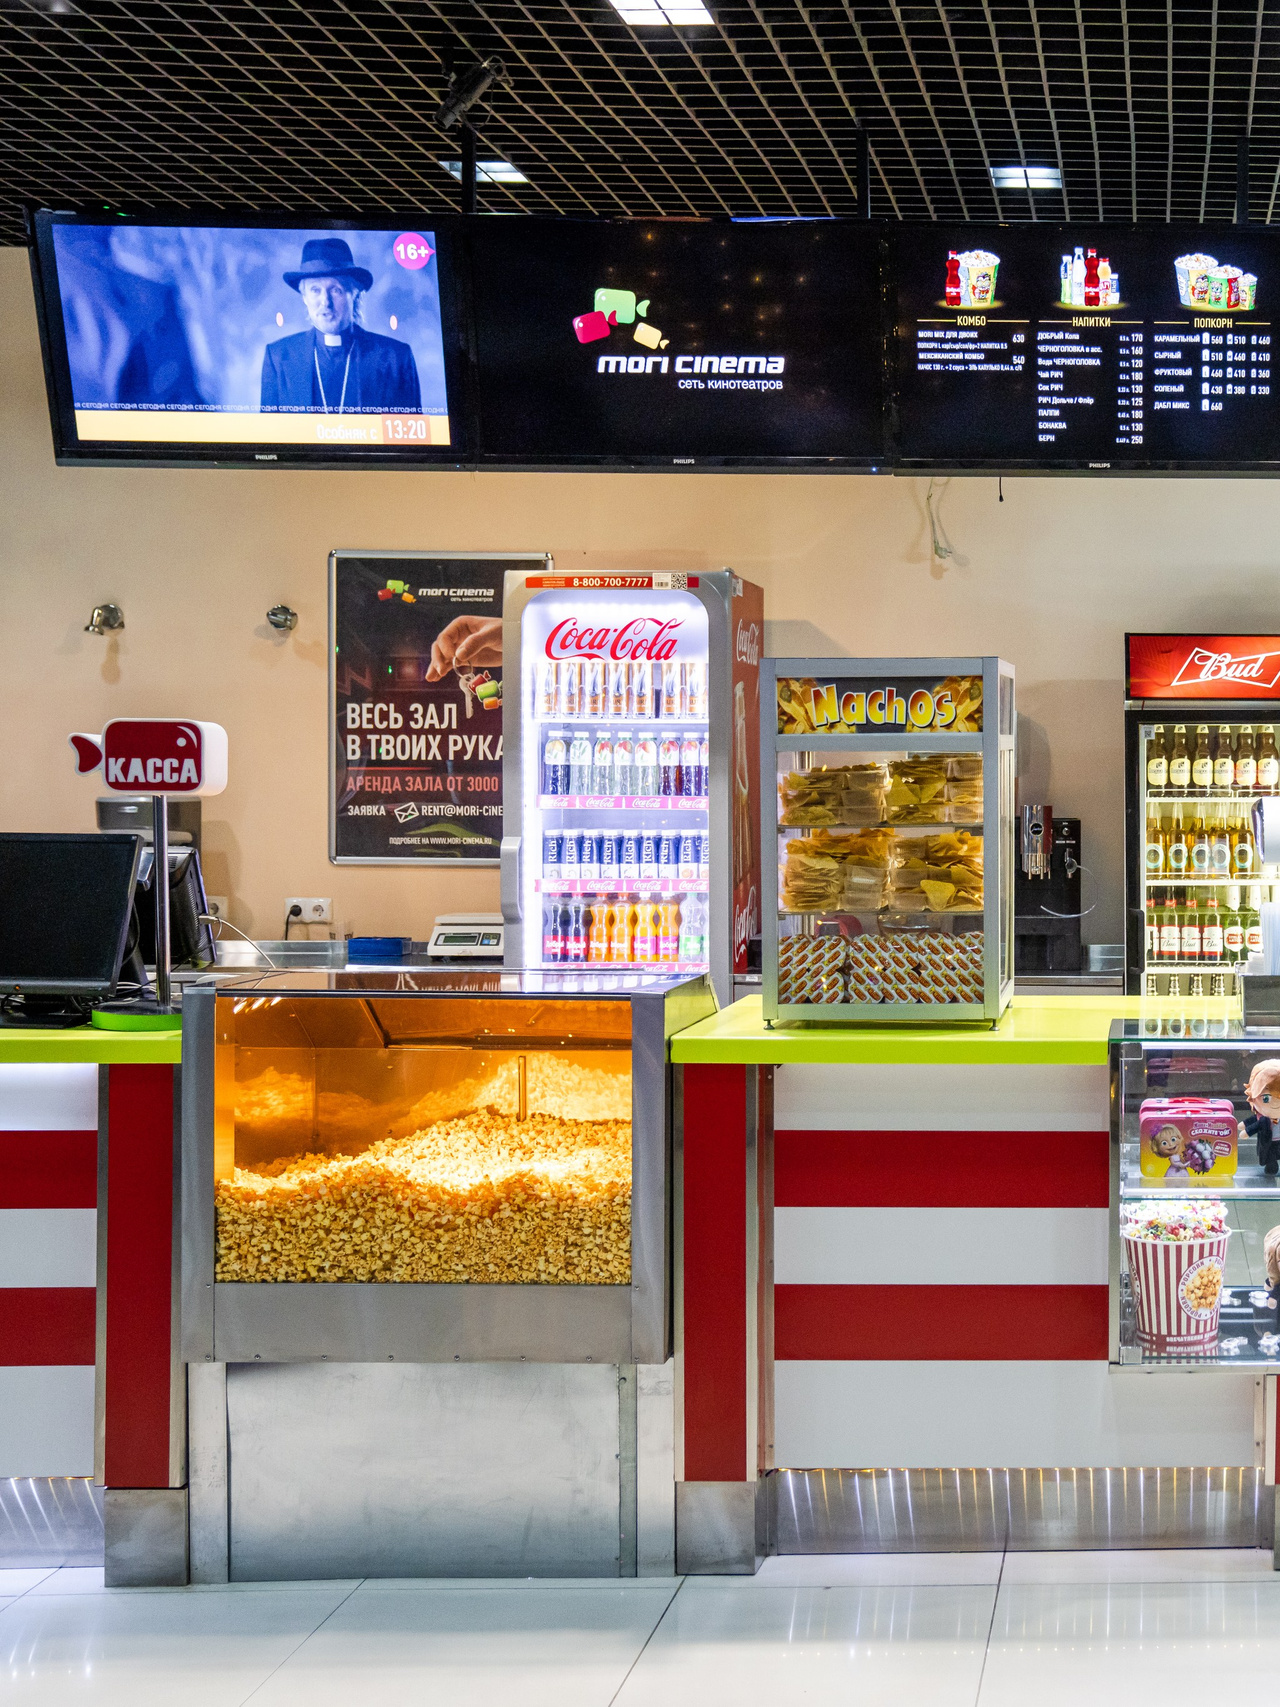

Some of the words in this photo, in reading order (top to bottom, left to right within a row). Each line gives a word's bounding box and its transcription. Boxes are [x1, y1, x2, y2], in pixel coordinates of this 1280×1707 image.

[396, 243, 429, 260] 16+
[957, 316, 986, 326] КОМБО
[1072, 316, 1111, 327] НАПИТКИ
[1194, 318, 1233, 328] ПОПКОРН
[1012, 334, 1024, 343] 630
[1038, 331, 1064, 340] ДОБРЫЙ
[1131, 333, 1143, 342] 170
[1154, 334, 1200, 342] КАРАМЕЛЬНЫЙ
[1154, 351, 1182, 359] СЫРНЫЙ
[597, 356, 670, 374] mori
[674, 356, 786, 374] cinema
[1154, 367, 1192, 376] ФРУКТОВЫЙ
[678, 380, 705, 390] сеть
[707, 380, 784, 392] кинотеатров
[1154, 402, 1172, 410] ДАБЛ
[1172, 402, 1190, 410] МИКС
[386, 420, 426, 440] 13:20
[1038, 422, 1067, 430] БОНАКВА
[1038, 434, 1056, 442] БЕРН
[1131, 436, 1143, 444] 250
[573, 577, 649, 587] 8-800-700-7777
[418, 588, 448, 596] mori
[449, 588, 495, 596] cinema
[545, 617, 686, 661] Coca-Cola
[1194, 652, 1264, 680] Bud
[810, 684, 956, 728] Nachos
[346, 702, 404, 730] ВЕСЬ
[409, 703, 458, 730] ЗАЛ
[346, 734, 362, 760] В
[366, 734, 442, 760] ТВОИХ
[108, 758, 199, 784] КАССА
[346, 776, 402, 794] АРЕНДА
[404, 776, 444, 792] ЗАЛА
[446, 776, 464, 792] ОТ
[467, 776, 498, 792] 3000
[585, 797, 615, 808] Coca-Cola
[348, 806, 386, 816] ЗАЯВКА
[389, 837, 422, 845] ПОДРОБНЕЕ
[548, 840, 557, 862] Rich
[625, 840, 634, 864] Rich
[682, 840, 692, 863] Rich
[633, 880, 662, 891] Coca-Cola
